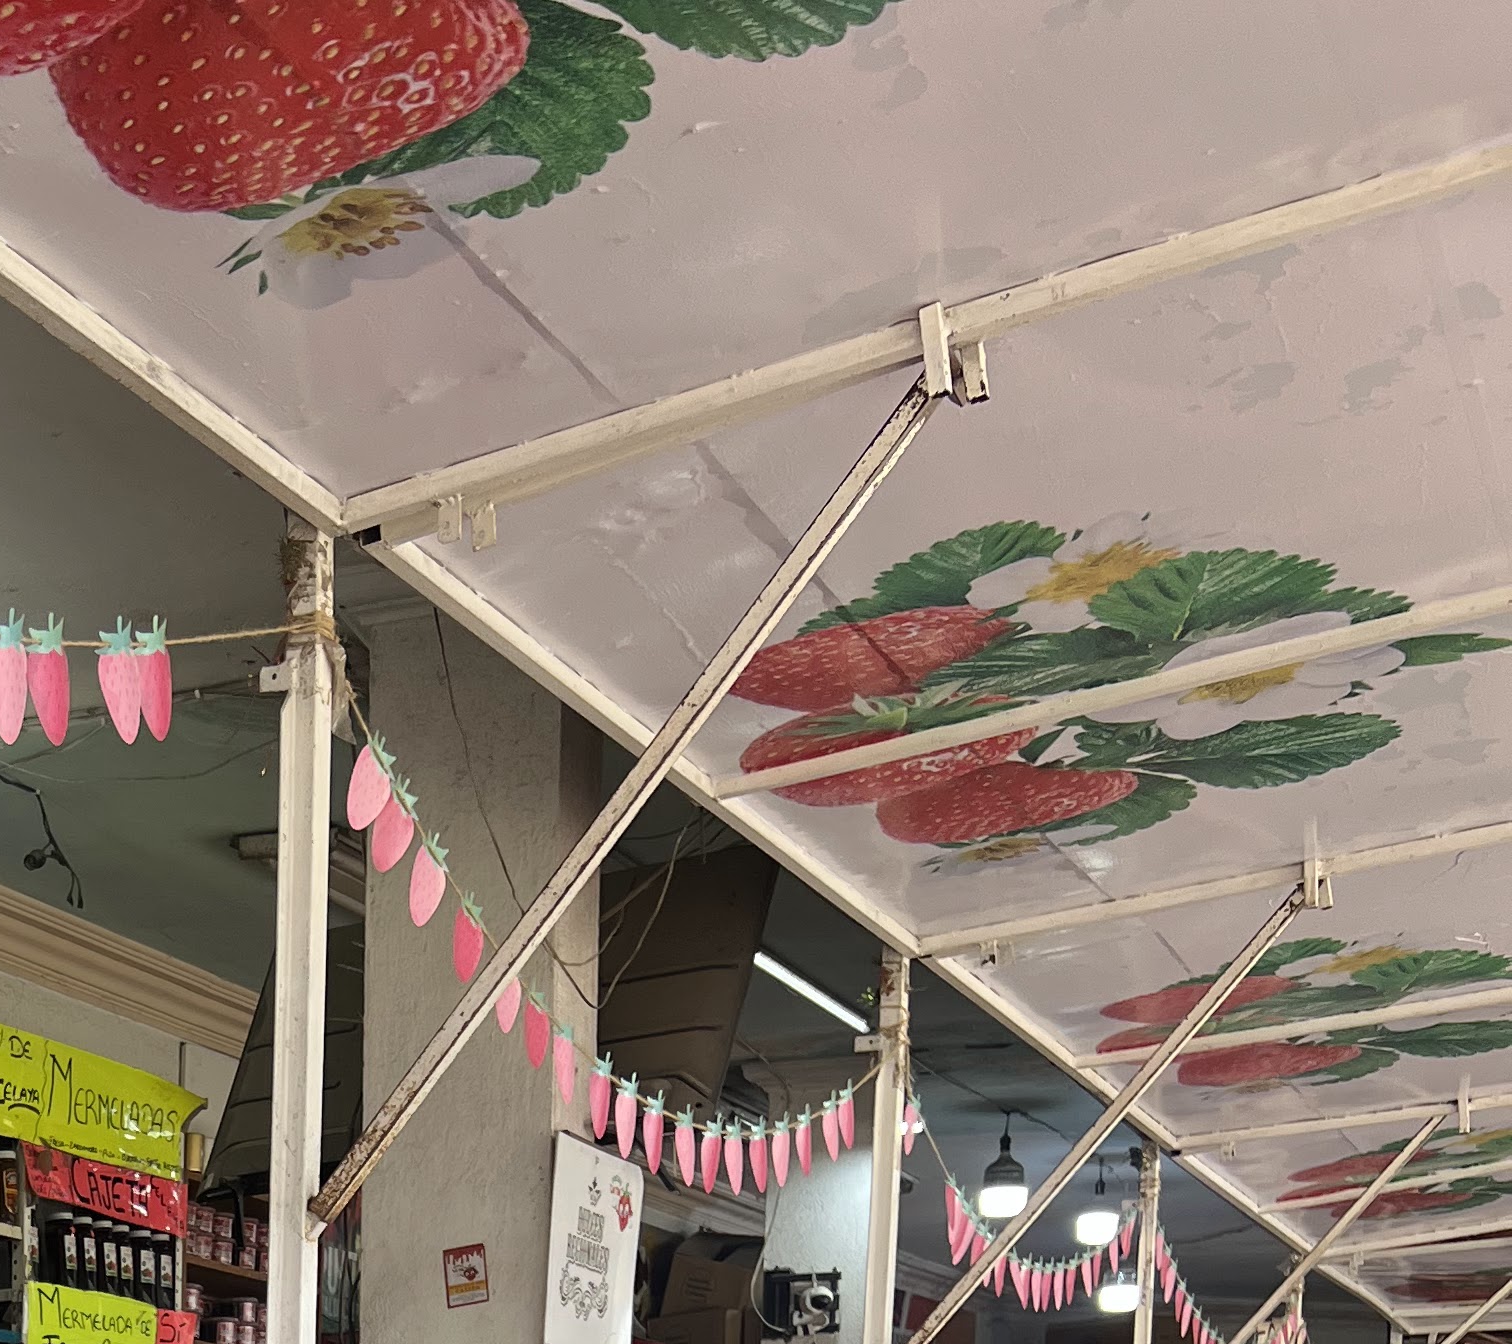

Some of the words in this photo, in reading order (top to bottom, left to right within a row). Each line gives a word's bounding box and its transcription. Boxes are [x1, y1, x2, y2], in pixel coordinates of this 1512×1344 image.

[9, 1034, 33, 1061] DE
[47, 1053, 178, 1142] MERMELADAS
[71, 1157, 149, 1218] CAJETA
[37, 1286, 133, 1338] MERMELADA
